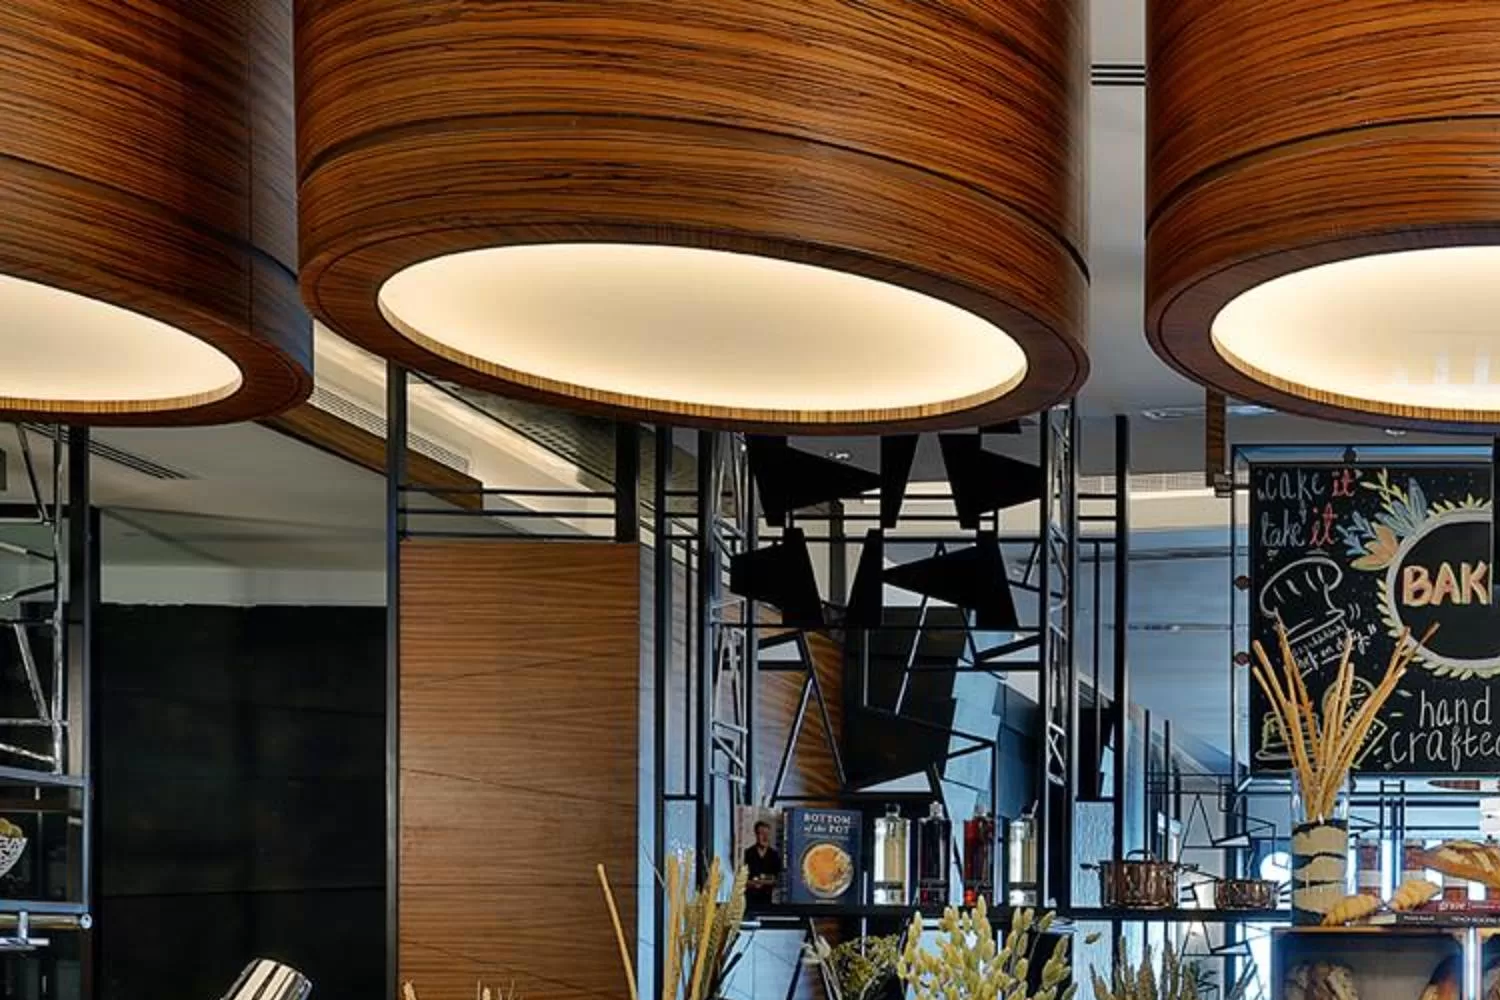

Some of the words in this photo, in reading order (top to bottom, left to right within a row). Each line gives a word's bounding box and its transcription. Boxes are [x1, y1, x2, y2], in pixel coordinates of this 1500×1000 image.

[1309, 503, 1337, 545] it
[1420, 686, 1493, 729] hand
[804, 812, 851, 825] BOTTOM
[829, 825, 850, 834] POT
